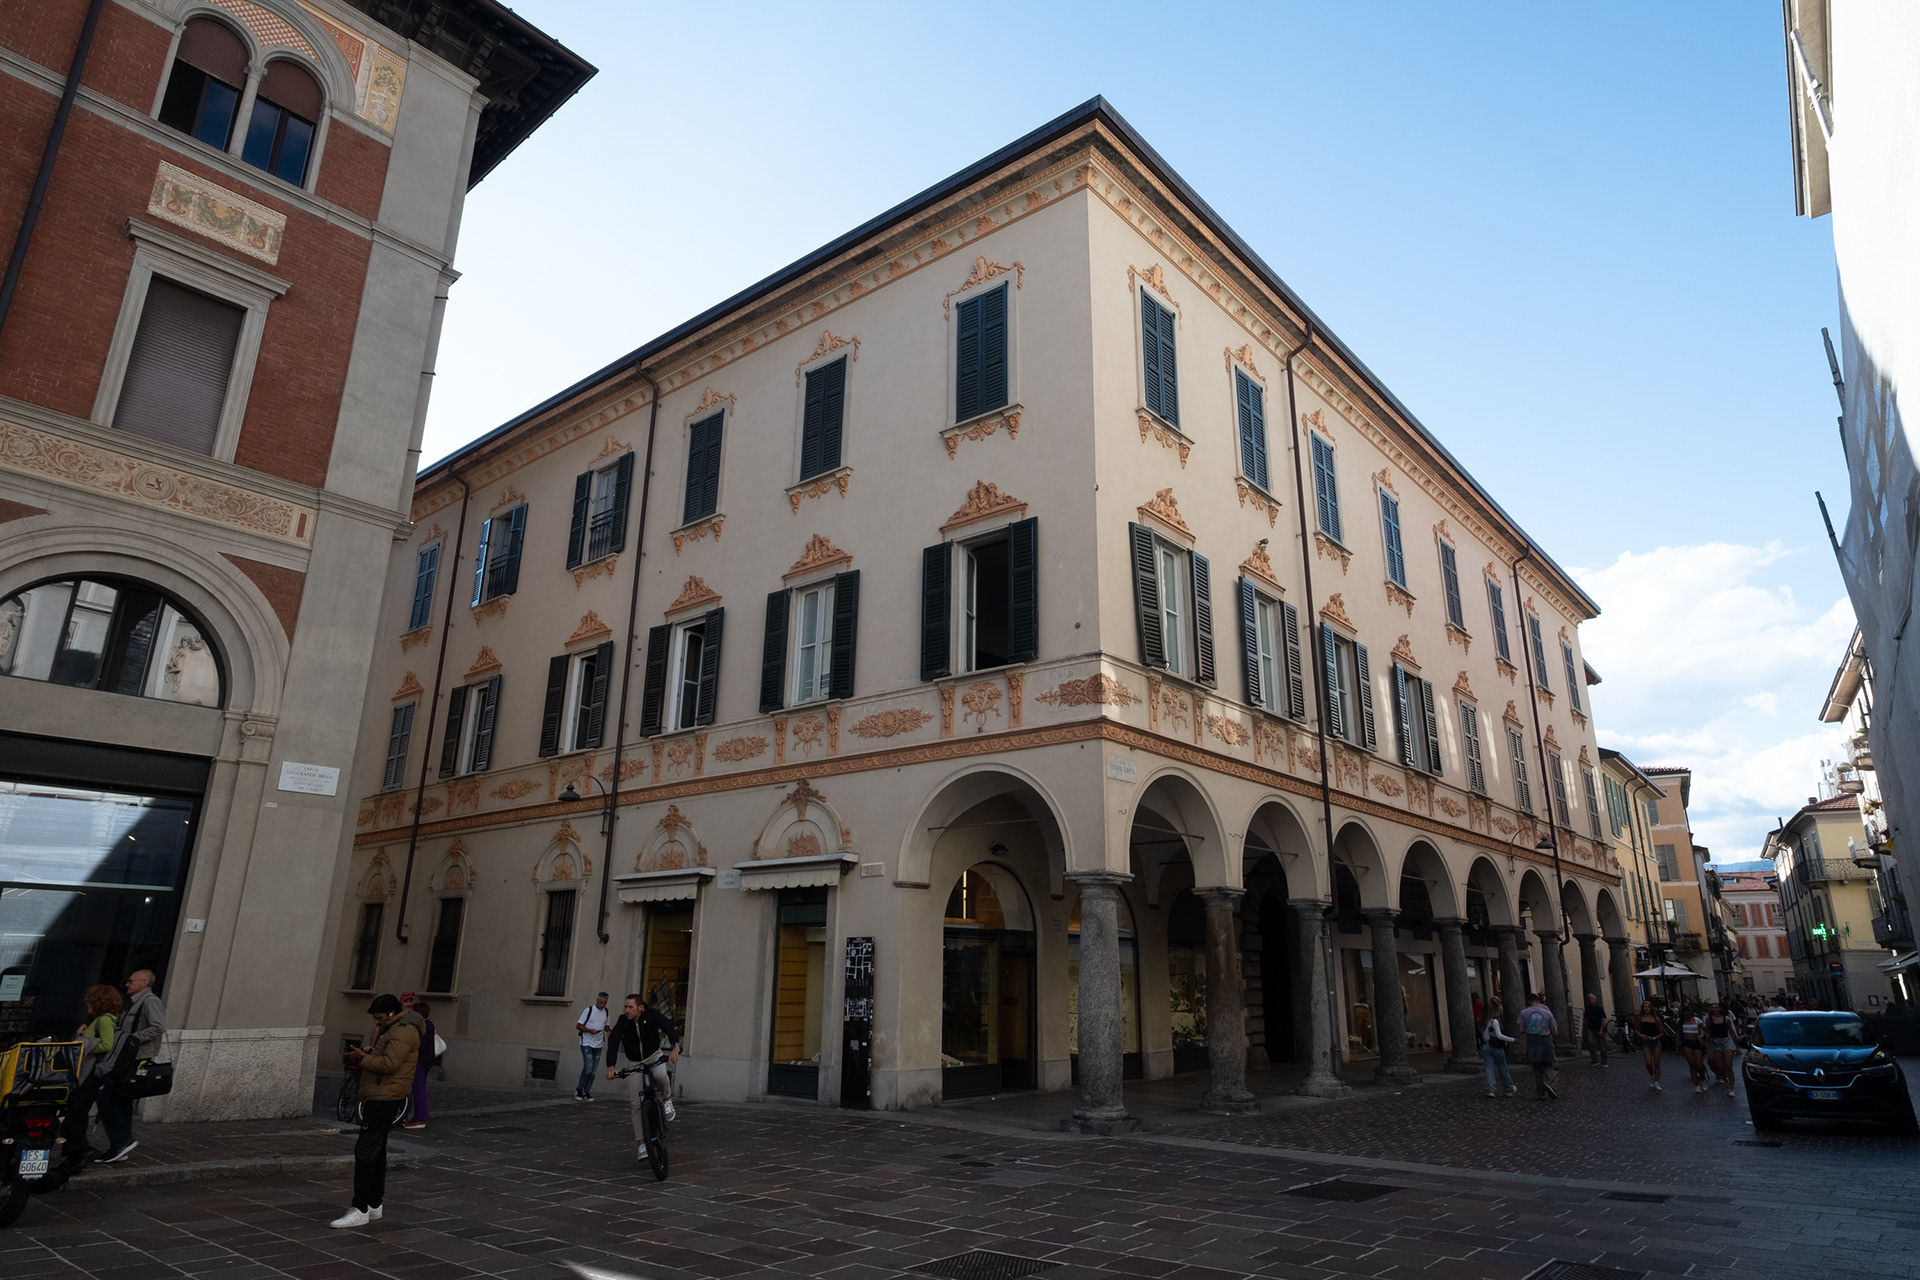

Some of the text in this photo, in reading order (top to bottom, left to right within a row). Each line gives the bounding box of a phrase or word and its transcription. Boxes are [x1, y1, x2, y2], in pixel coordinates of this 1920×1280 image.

[1637, 950, 1647, 961] T
[28, 1150, 40, 1160] FS
[20, 1161, 47, 1172] 60640
